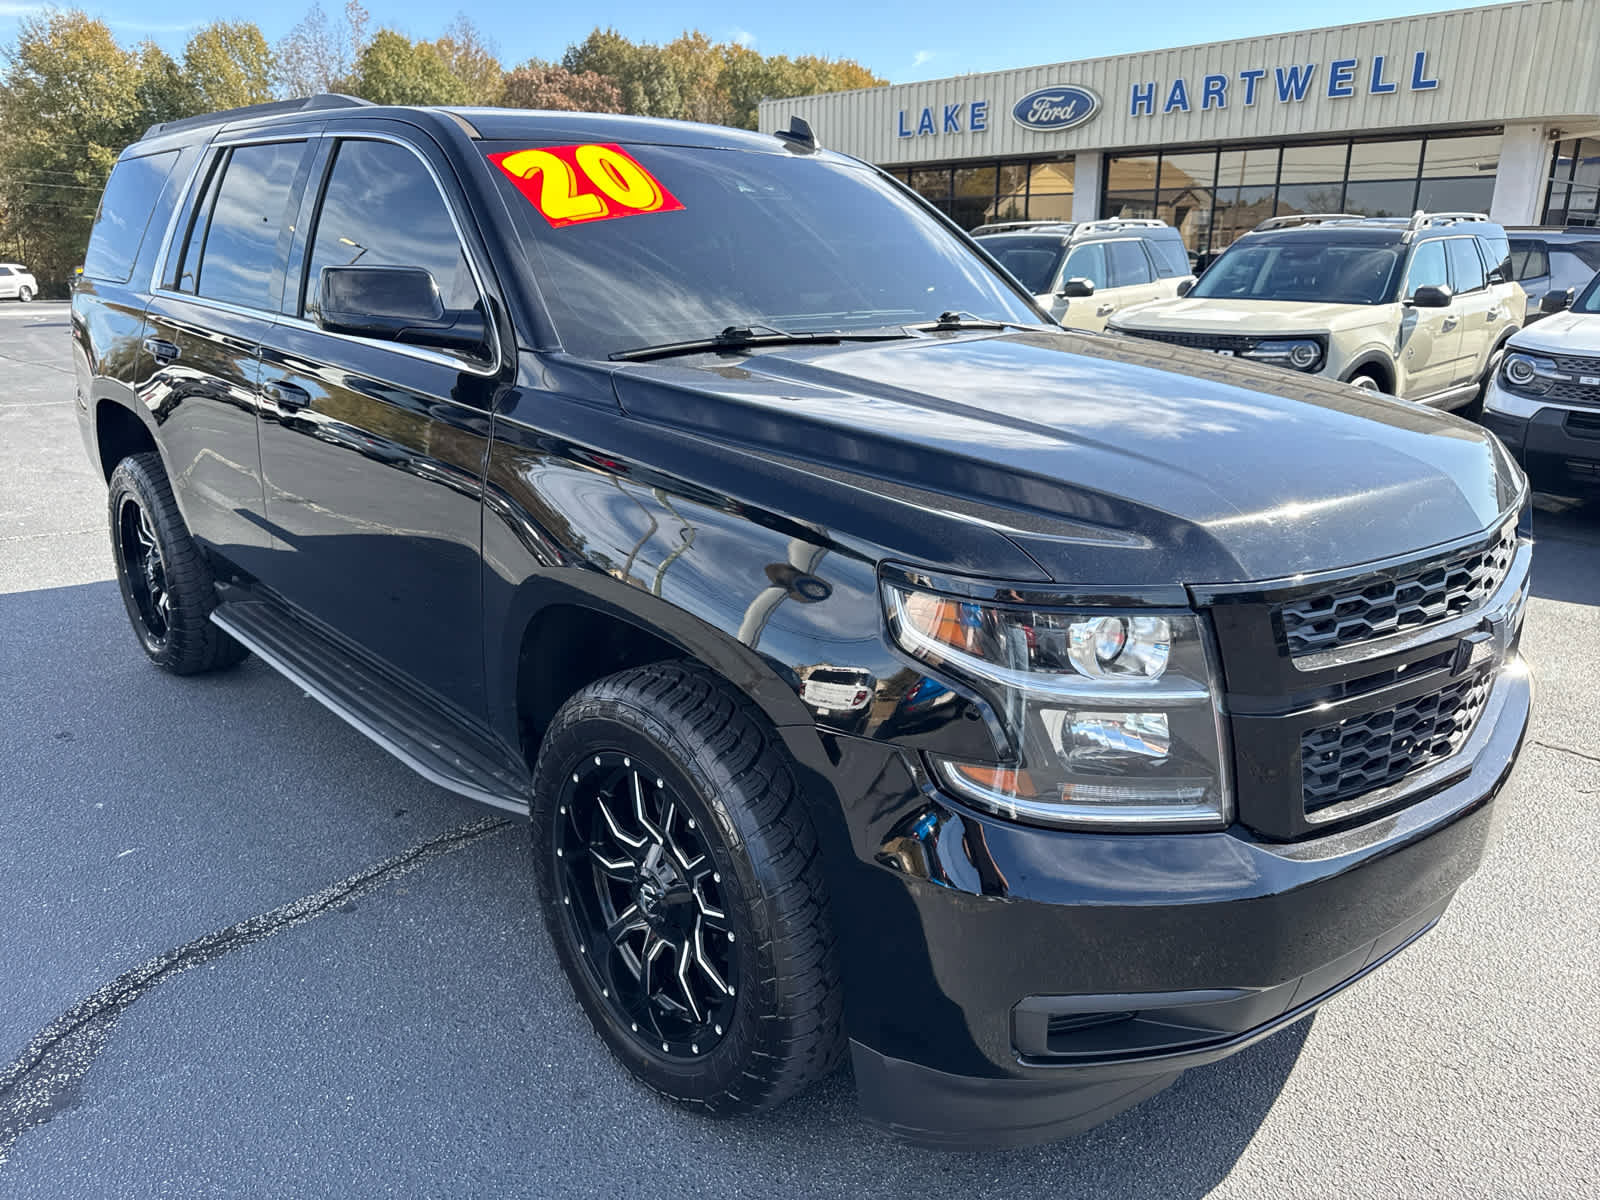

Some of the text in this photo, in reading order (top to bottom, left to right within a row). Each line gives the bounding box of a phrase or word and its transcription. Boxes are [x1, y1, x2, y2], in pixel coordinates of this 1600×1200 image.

[898, 51, 1438, 138] LAKE Ford HARTWELL
[501, 144, 664, 221] 20
